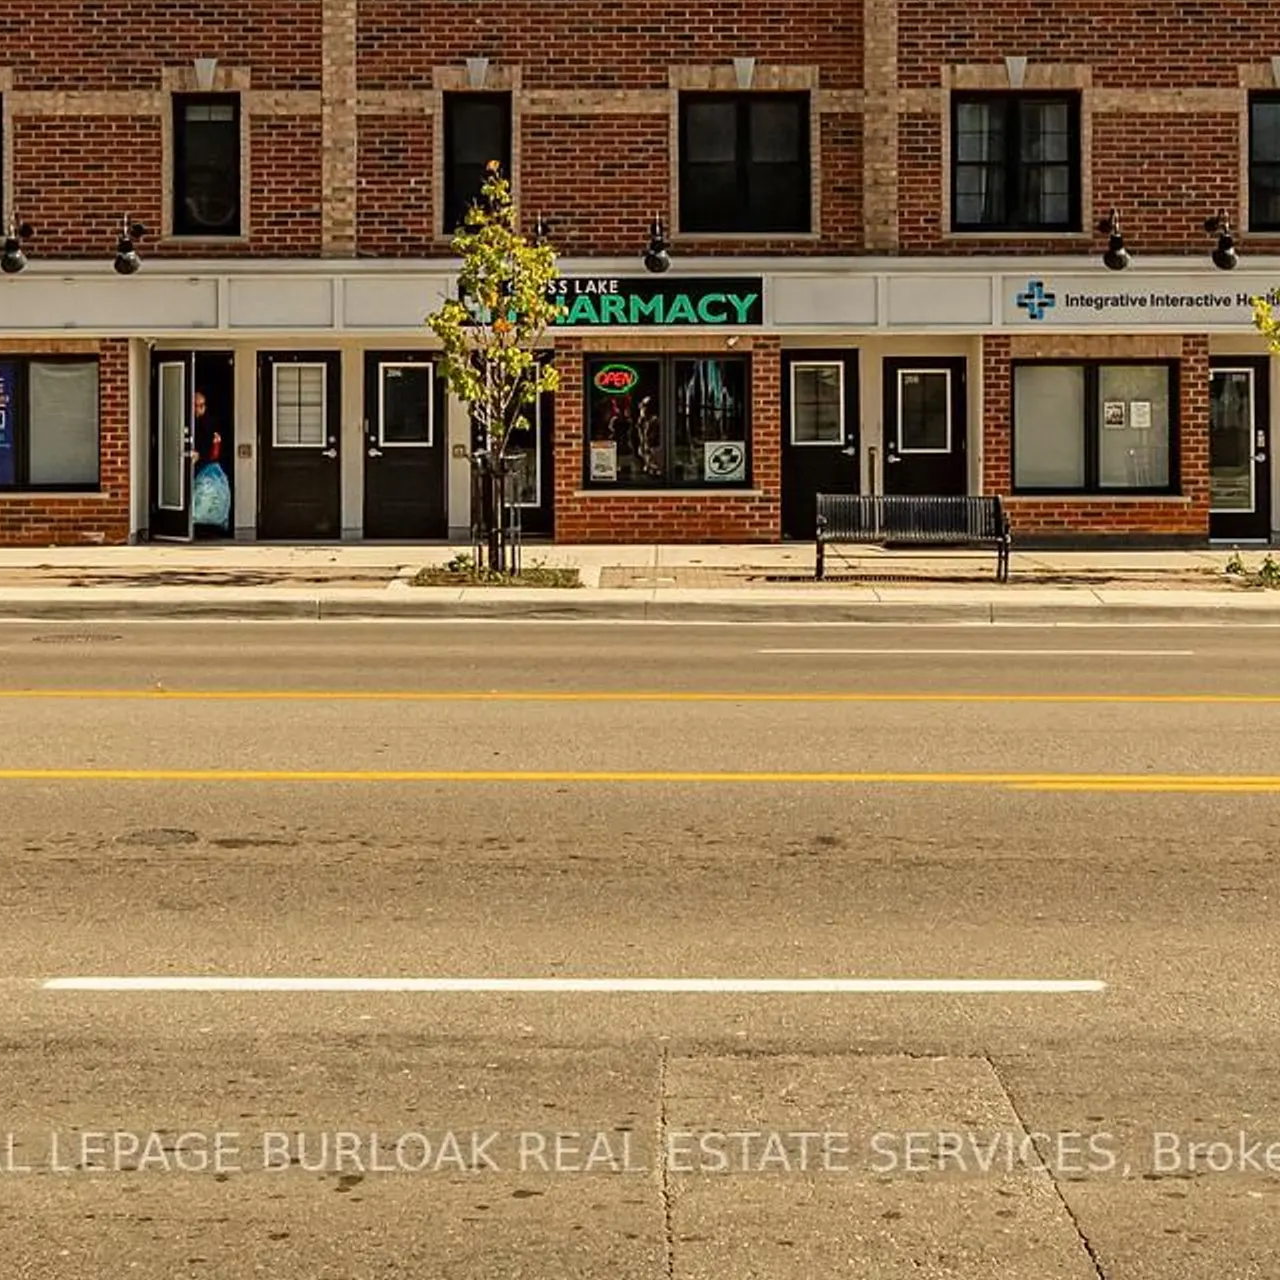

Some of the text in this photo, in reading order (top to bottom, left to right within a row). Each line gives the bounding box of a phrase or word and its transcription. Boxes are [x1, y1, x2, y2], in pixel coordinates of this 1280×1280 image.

[574, 280, 619, 294] LAKE
[1065, 293, 1150, 309] Integrative
[1151, 293, 1231, 307] Interactive
[594, 371, 633, 387] OPEN
